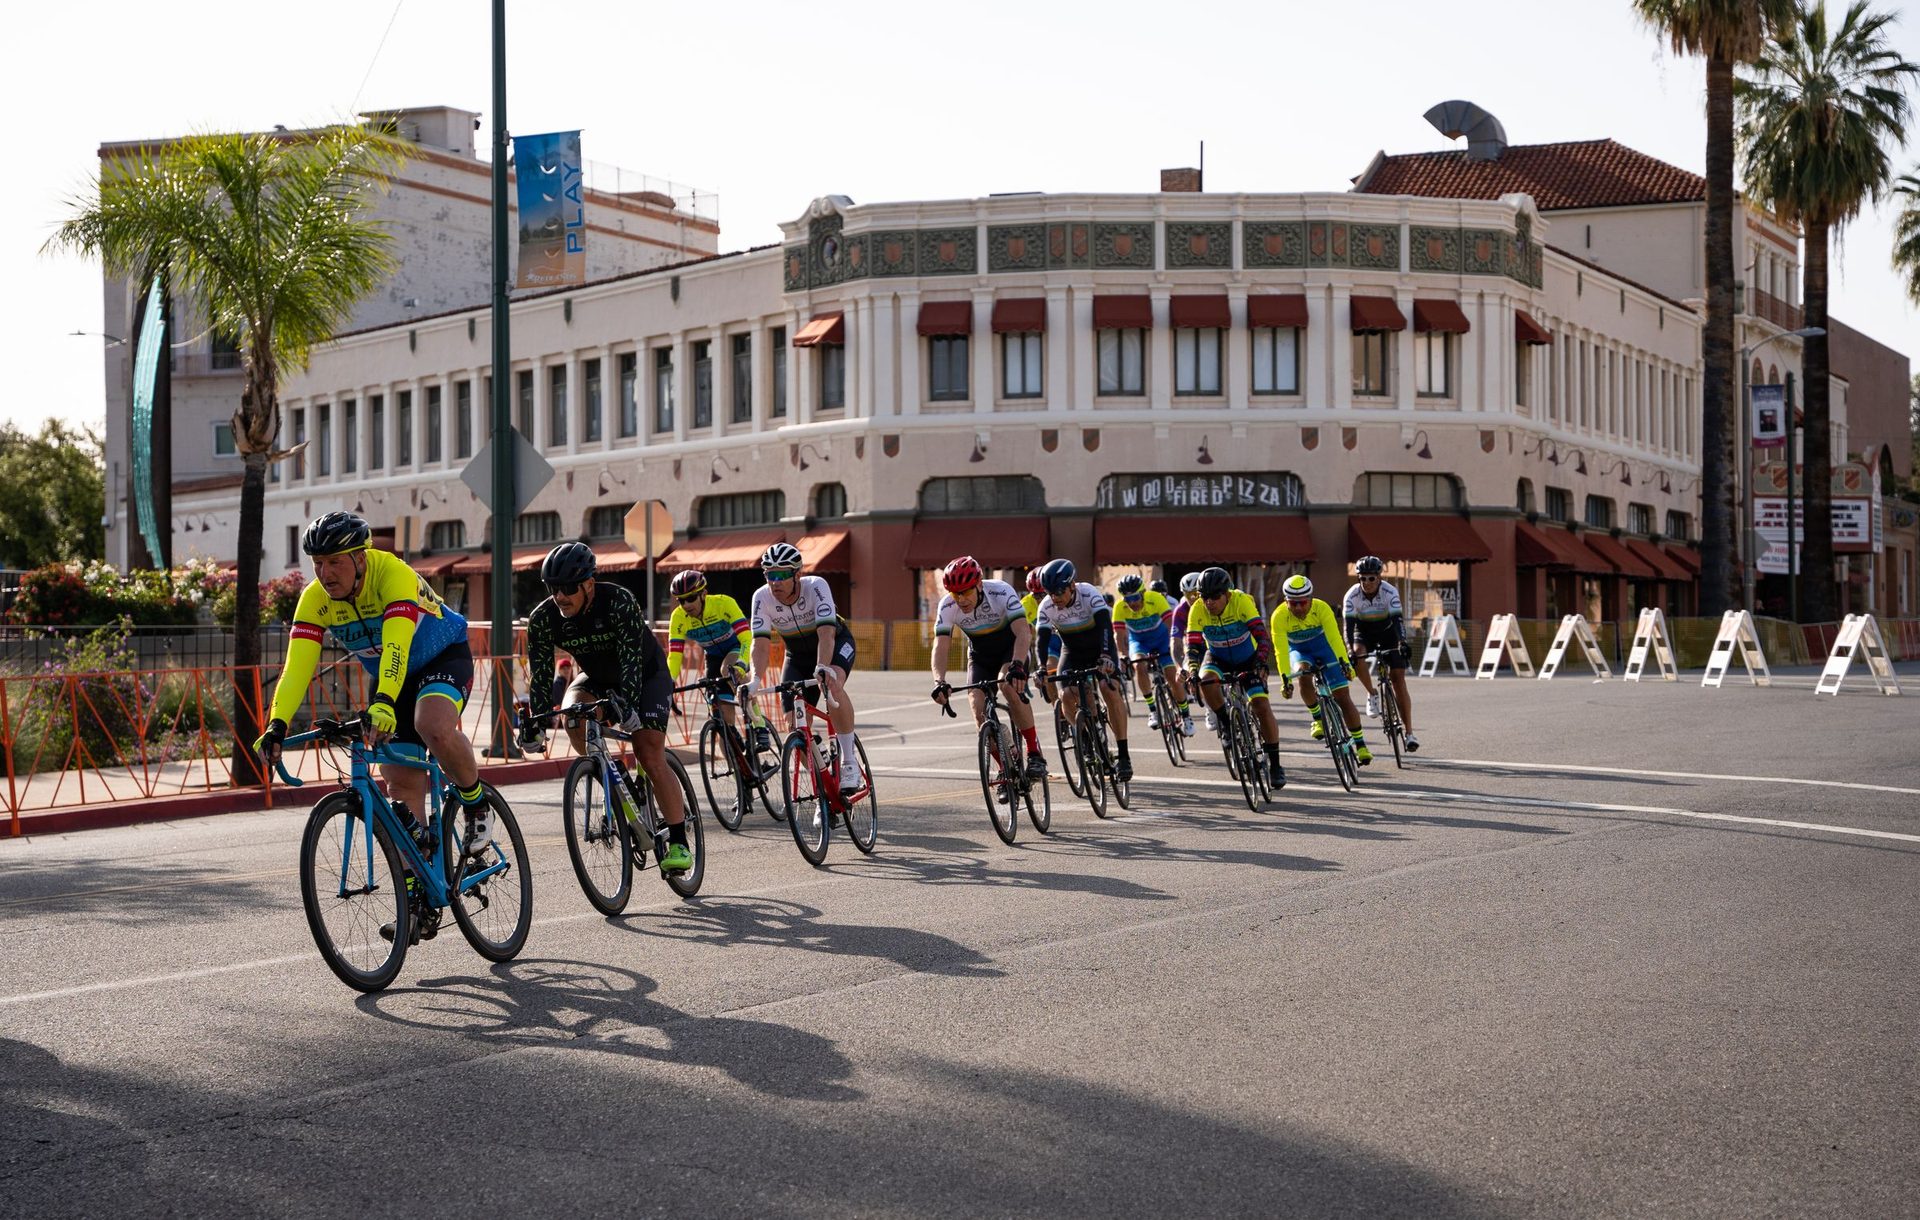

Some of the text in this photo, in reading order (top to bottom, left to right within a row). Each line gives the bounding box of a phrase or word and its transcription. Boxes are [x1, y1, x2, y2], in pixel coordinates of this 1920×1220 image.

[563, 162, 583, 253] PLAY
[1123, 475, 1280, 507] WOOD FIRED PIZZA
